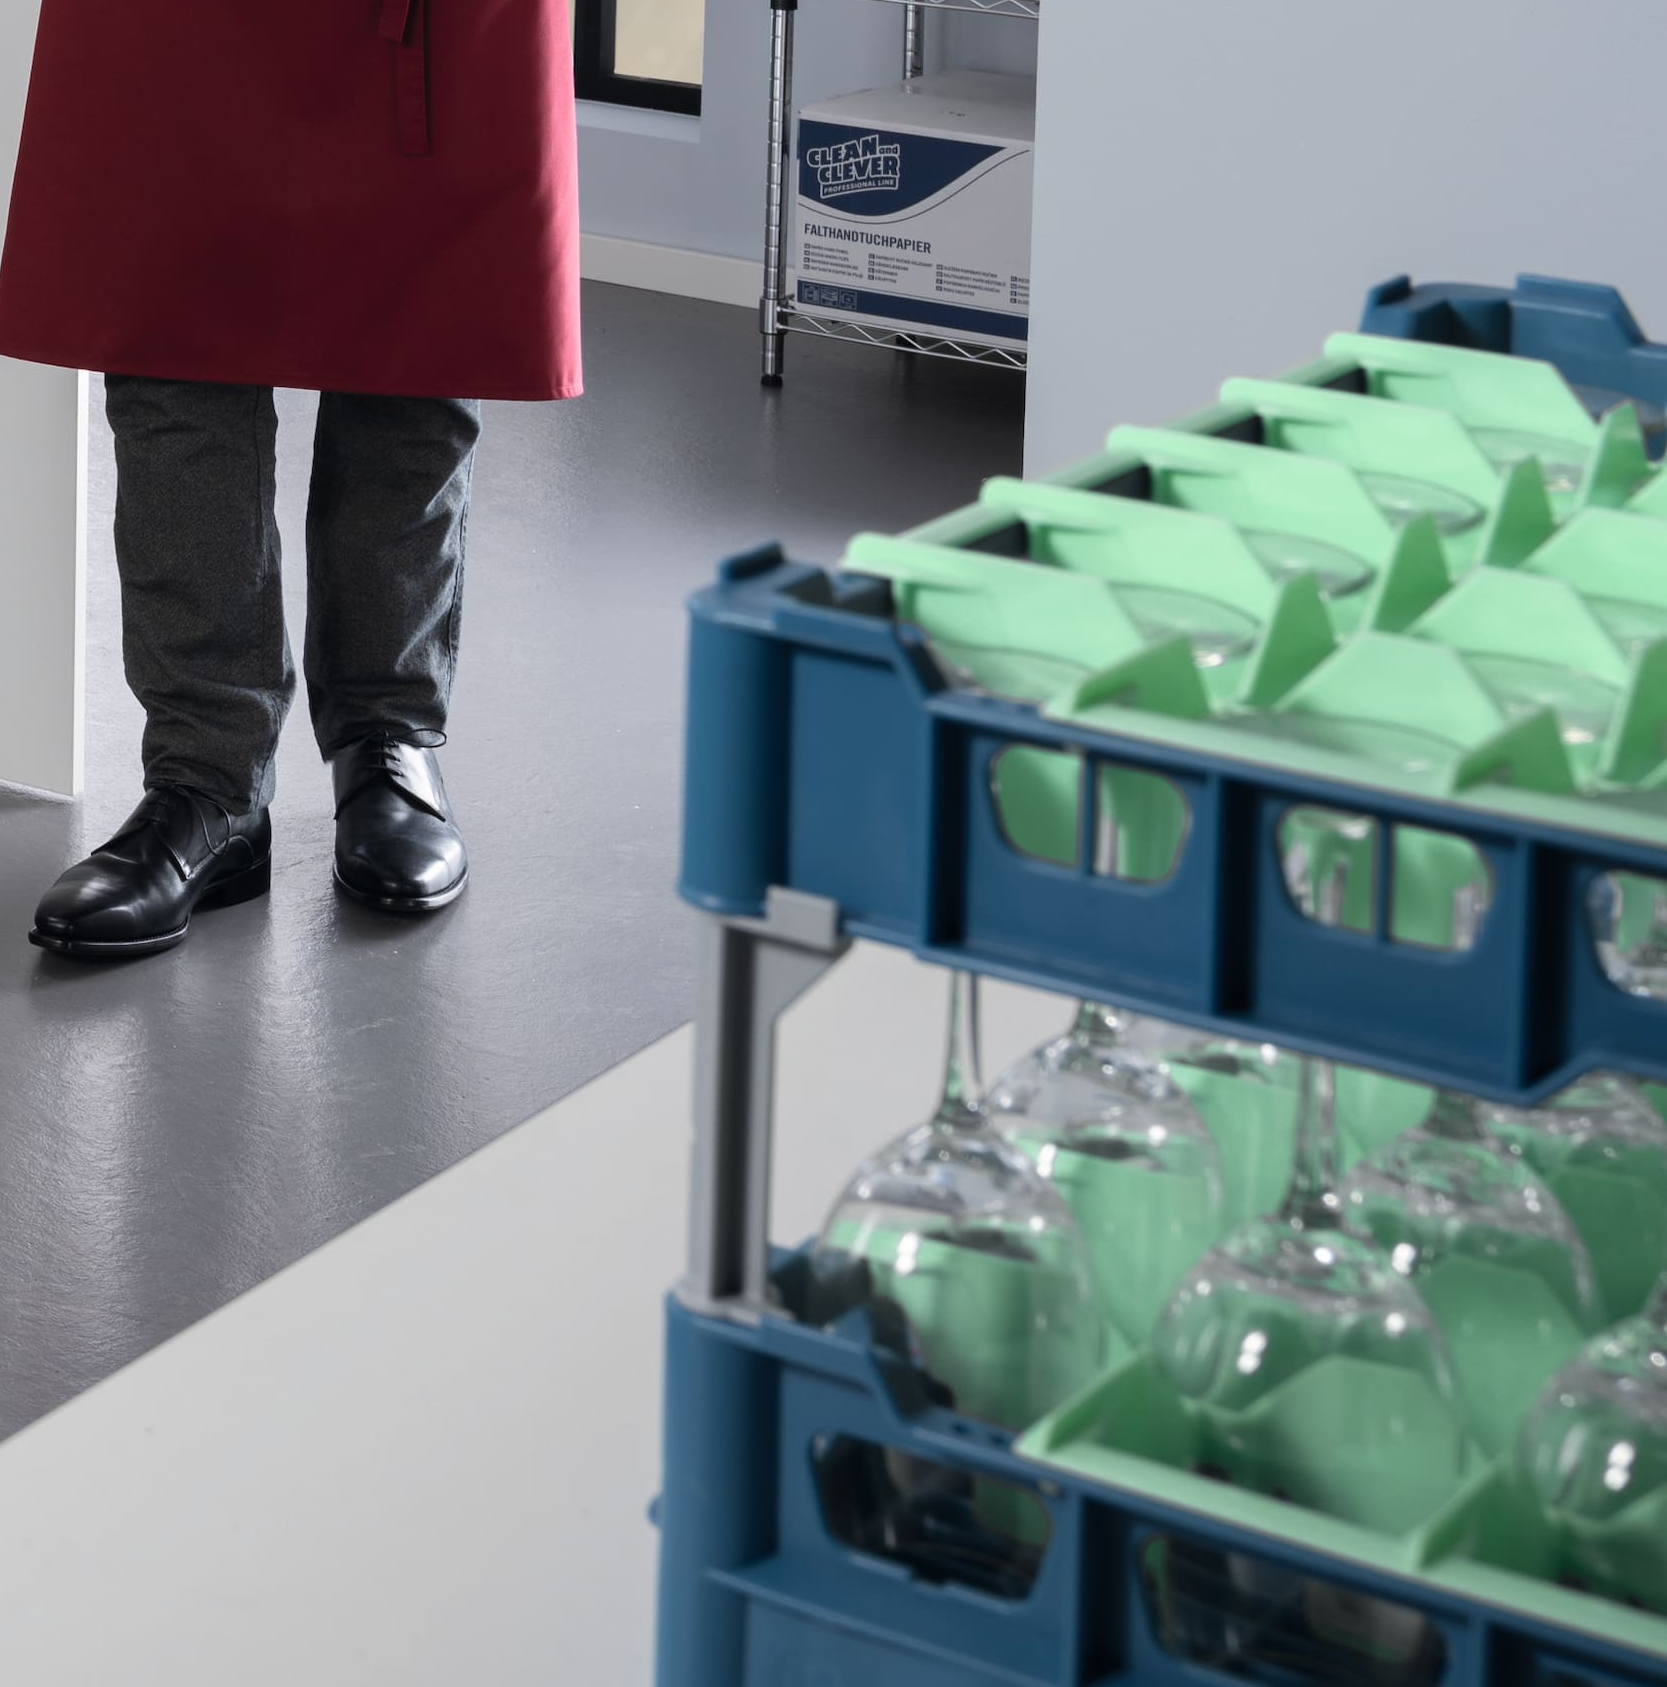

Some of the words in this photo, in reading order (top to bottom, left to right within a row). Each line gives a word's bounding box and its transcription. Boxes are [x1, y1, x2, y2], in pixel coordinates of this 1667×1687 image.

[807, 134, 879, 168] CLEAN
[878, 144, 901, 155] and
[818, 154, 901, 185] CLEVER
[824, 180, 876, 194] PROFESSIONAL
[804, 223, 932, 254] FALTHANDTUCHPAPIER
